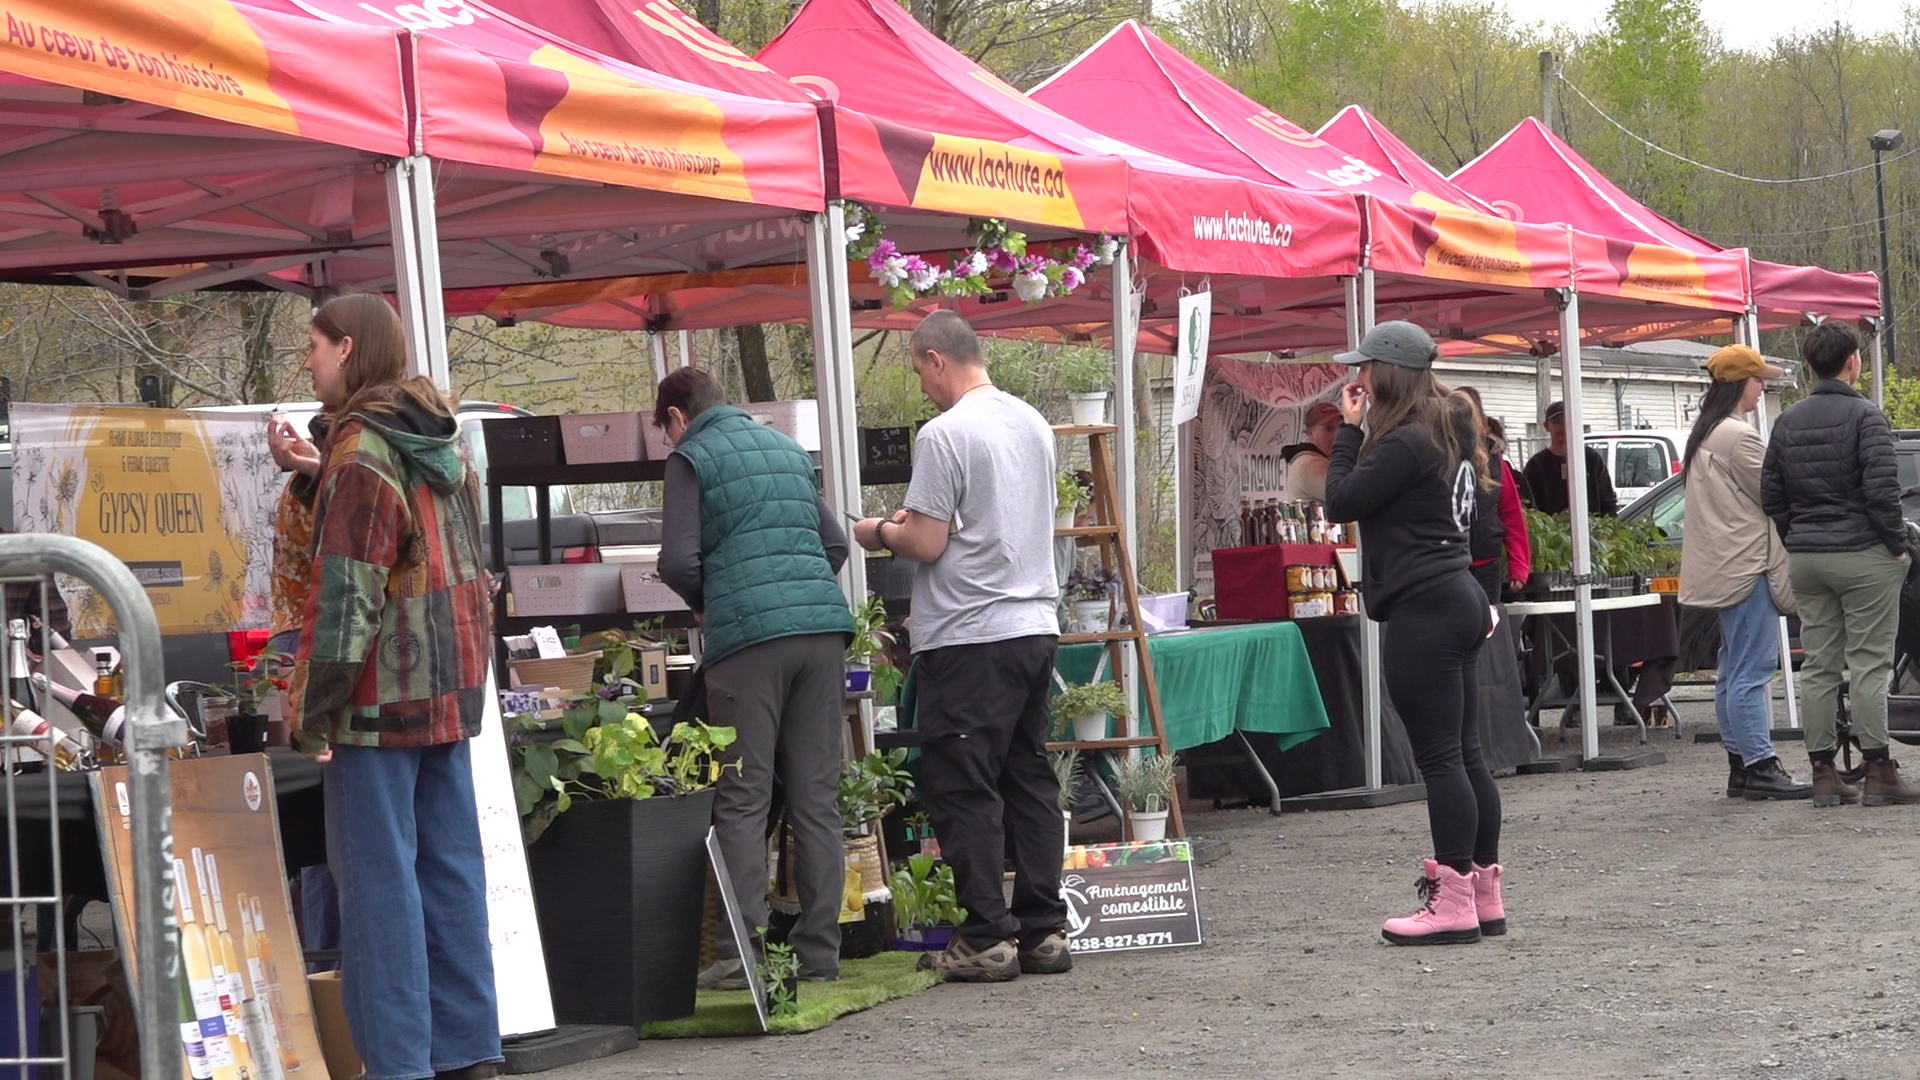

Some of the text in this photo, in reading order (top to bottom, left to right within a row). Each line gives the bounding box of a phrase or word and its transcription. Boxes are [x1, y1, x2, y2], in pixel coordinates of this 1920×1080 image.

[6, 11, 244, 96] Au cœur de ton histoire
[560, 132, 586, 155] Au
[624, 141, 646, 165] de
[647, 146, 672, 169] ton
[672, 148, 721, 176] histoire
[929, 147, 1065, 199] www.lachute.ca
[1193, 210, 1293, 247] www.lachute.ca
[1251, 453, 1289, 492] ROQUE
[99, 491, 205, 537] GYPSY QUEEN
[1086, 878, 1189, 900] Aménagement
[1101, 895, 1186, 916] comestible
[1070, 931, 1173, 951] 438-827-8771
